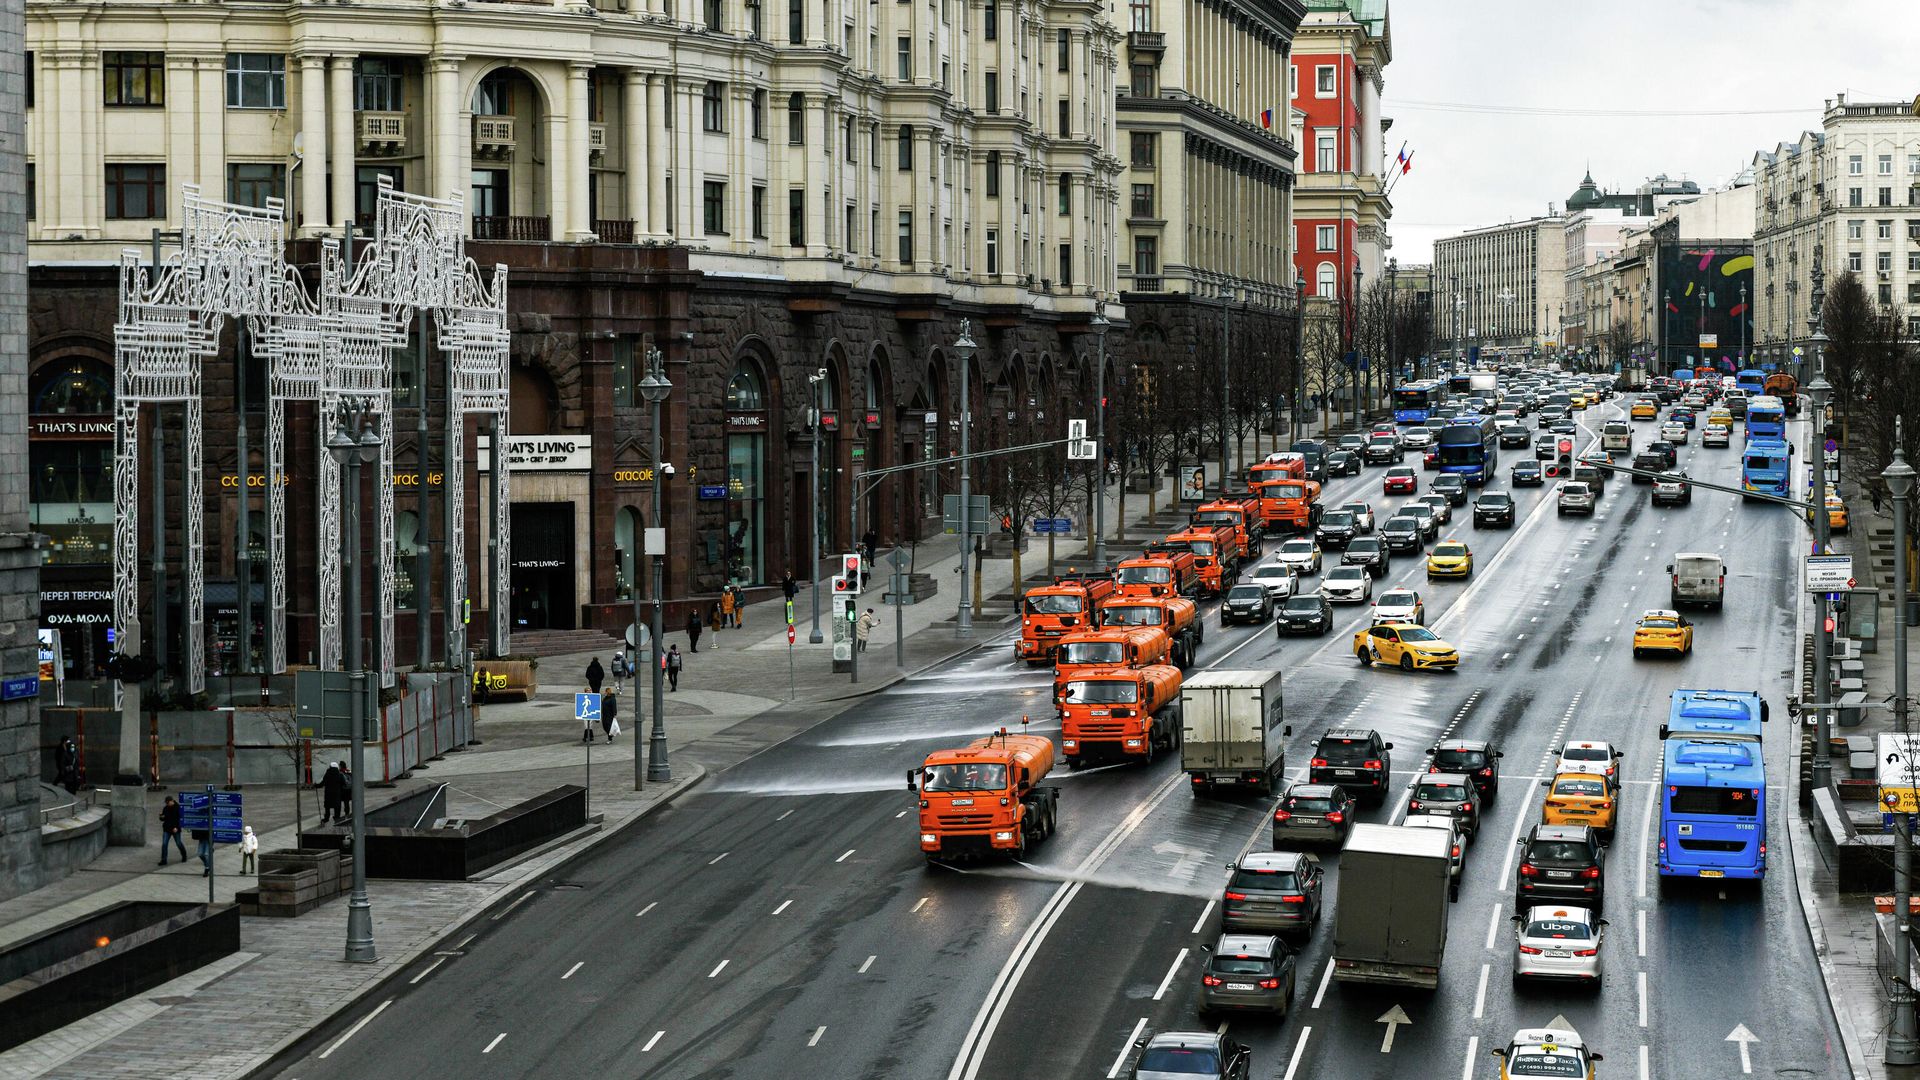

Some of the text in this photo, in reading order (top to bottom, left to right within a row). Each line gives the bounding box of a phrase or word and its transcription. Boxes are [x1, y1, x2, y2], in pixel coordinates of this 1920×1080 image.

[37, 422, 116, 433] THAT'S LIVING
[537, 442, 575, 454] LIVING
[518, 560, 539, 568] THAT'S
[40, 591, 70, 601] ЛЕРЕЯ
[47, 614, 111, 624] ФУД-МОЛЛ
[1541, 922, 1577, 931] Uber
[1558, 1057, 1578, 1065] Такси
